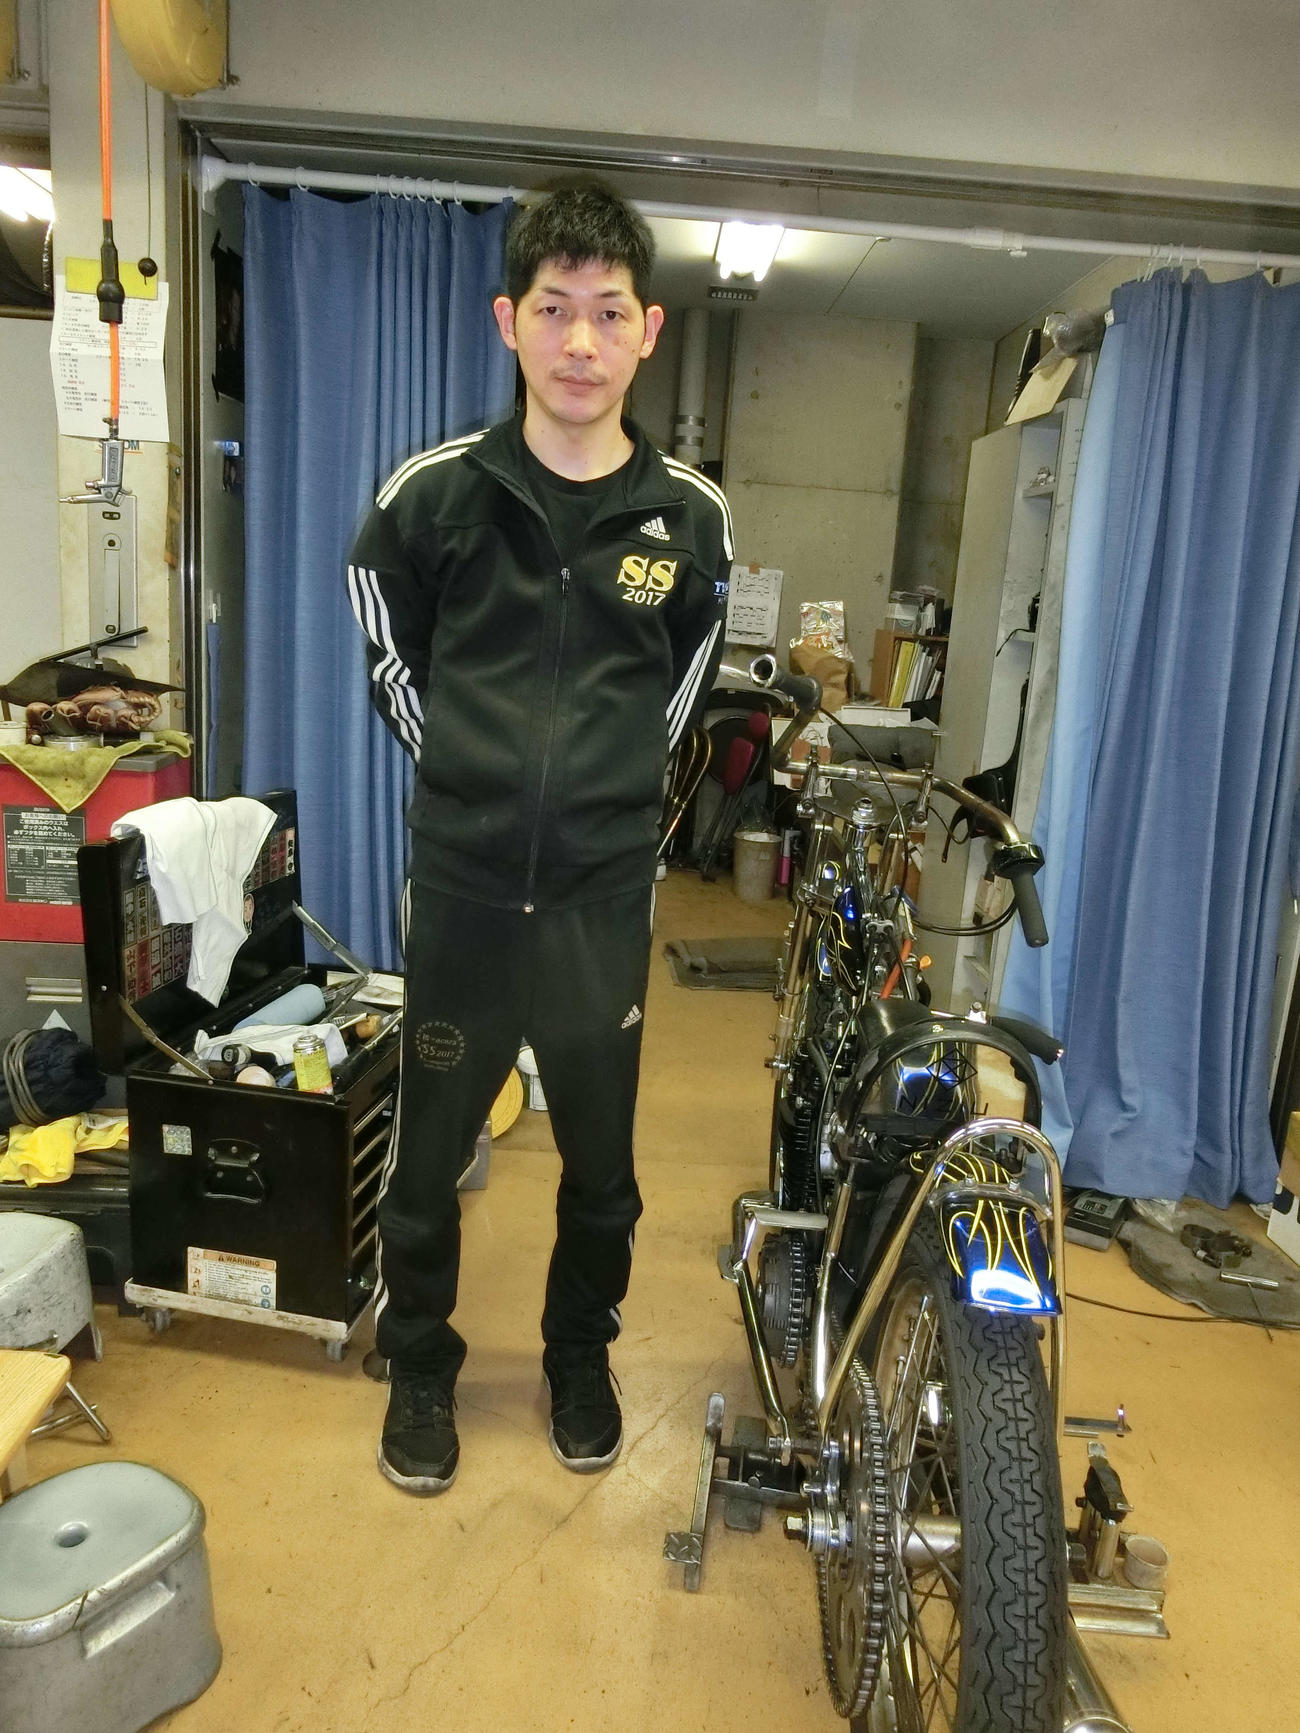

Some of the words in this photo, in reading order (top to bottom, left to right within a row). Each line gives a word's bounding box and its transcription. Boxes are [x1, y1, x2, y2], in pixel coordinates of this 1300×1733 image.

[640, 525, 671, 541] adidas
[617, 555, 678, 592] SS
[622, 587, 666, 606] 2017
[225, 1255, 261, 1267] WARNING
